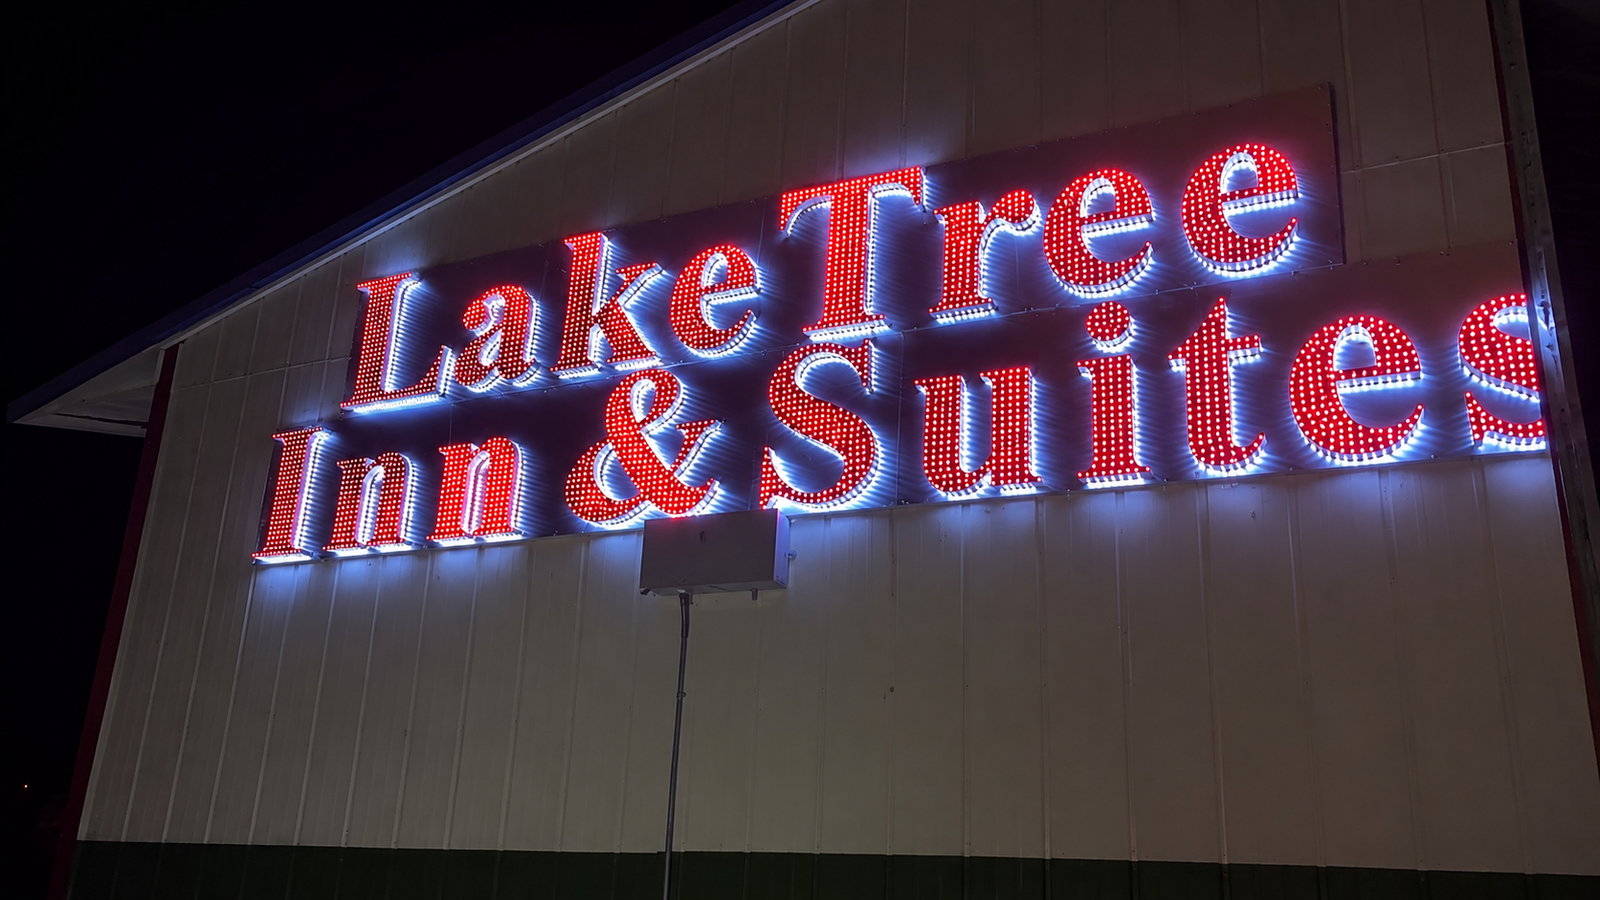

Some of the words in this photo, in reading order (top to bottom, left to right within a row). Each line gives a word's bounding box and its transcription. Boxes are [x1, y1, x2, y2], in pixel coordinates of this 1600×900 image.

[253, 426, 526, 563] Inn
[565, 370, 721, 528] &
[760, 294, 1547, 510] Suites
